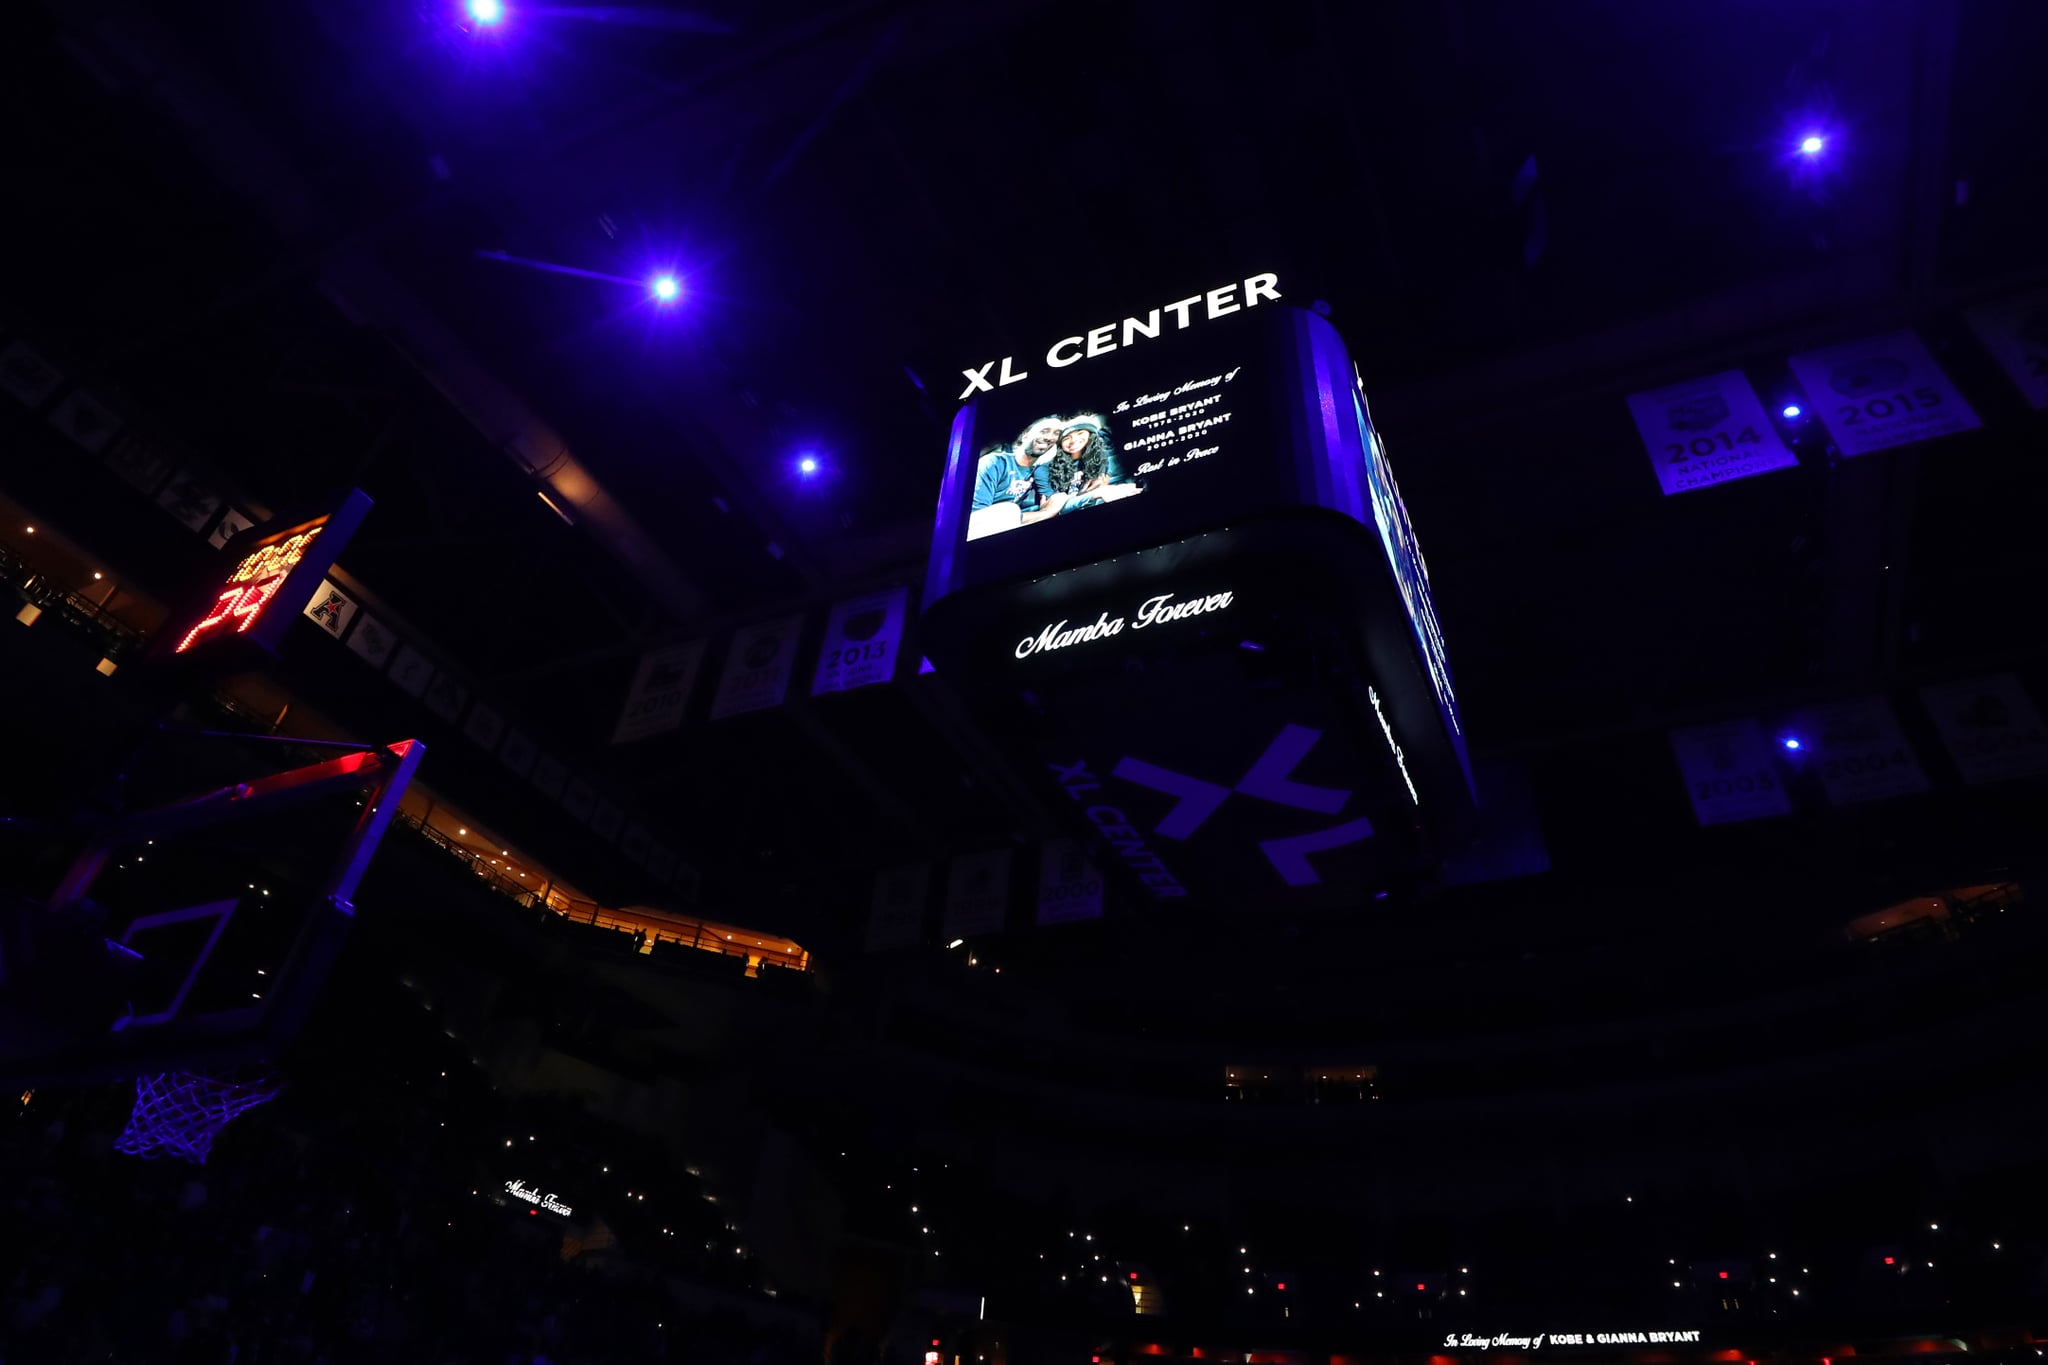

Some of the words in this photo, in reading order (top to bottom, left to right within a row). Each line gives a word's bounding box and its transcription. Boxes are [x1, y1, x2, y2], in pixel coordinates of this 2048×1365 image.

[959, 356, 1028, 400] XL
[1046, 272, 1282, 368] CENTER
[1133, 390, 1171, 408] Loving
[1173, 375, 1222, 396] Memory
[1224, 366, 1241, 383] of
[1837, 386, 1941, 426] 2015
[1132, 411, 1167, 428] KOBE
[1169, 394, 1222, 417] BRYANT
[1123, 430, 1176, 451] GIANNA
[1178, 413, 1232, 436] BRYANT
[1664, 424, 1762, 464] 2014
[1133, 458, 1165, 477] Rest
[1167, 456, 1182, 467] in
[1183, 446, 1220, 462] Peace
[1676, 449, 1766, 476] NATIONAL
[1014, 611, 1125, 660] Mamba
[1131, 590, 1234, 630] Forever
[826, 640, 887, 669] 2013
[1046, 758, 1102, 802] XL
[1085, 805, 1188, 899] CENTER
[1443, 1333, 1459, 1347] In
[1460, 1333, 1491, 1350] Loving
[1492, 1333, 1531, 1350] Memory
[1532, 1333, 1546, 1350] of
[1549, 1333, 1583, 1345] KOBE
[1586, 1333, 1595, 1345] &
[1597, 1332, 1648, 1345] GIANNA
[1649, 1330, 1700, 1343] BRYANT
